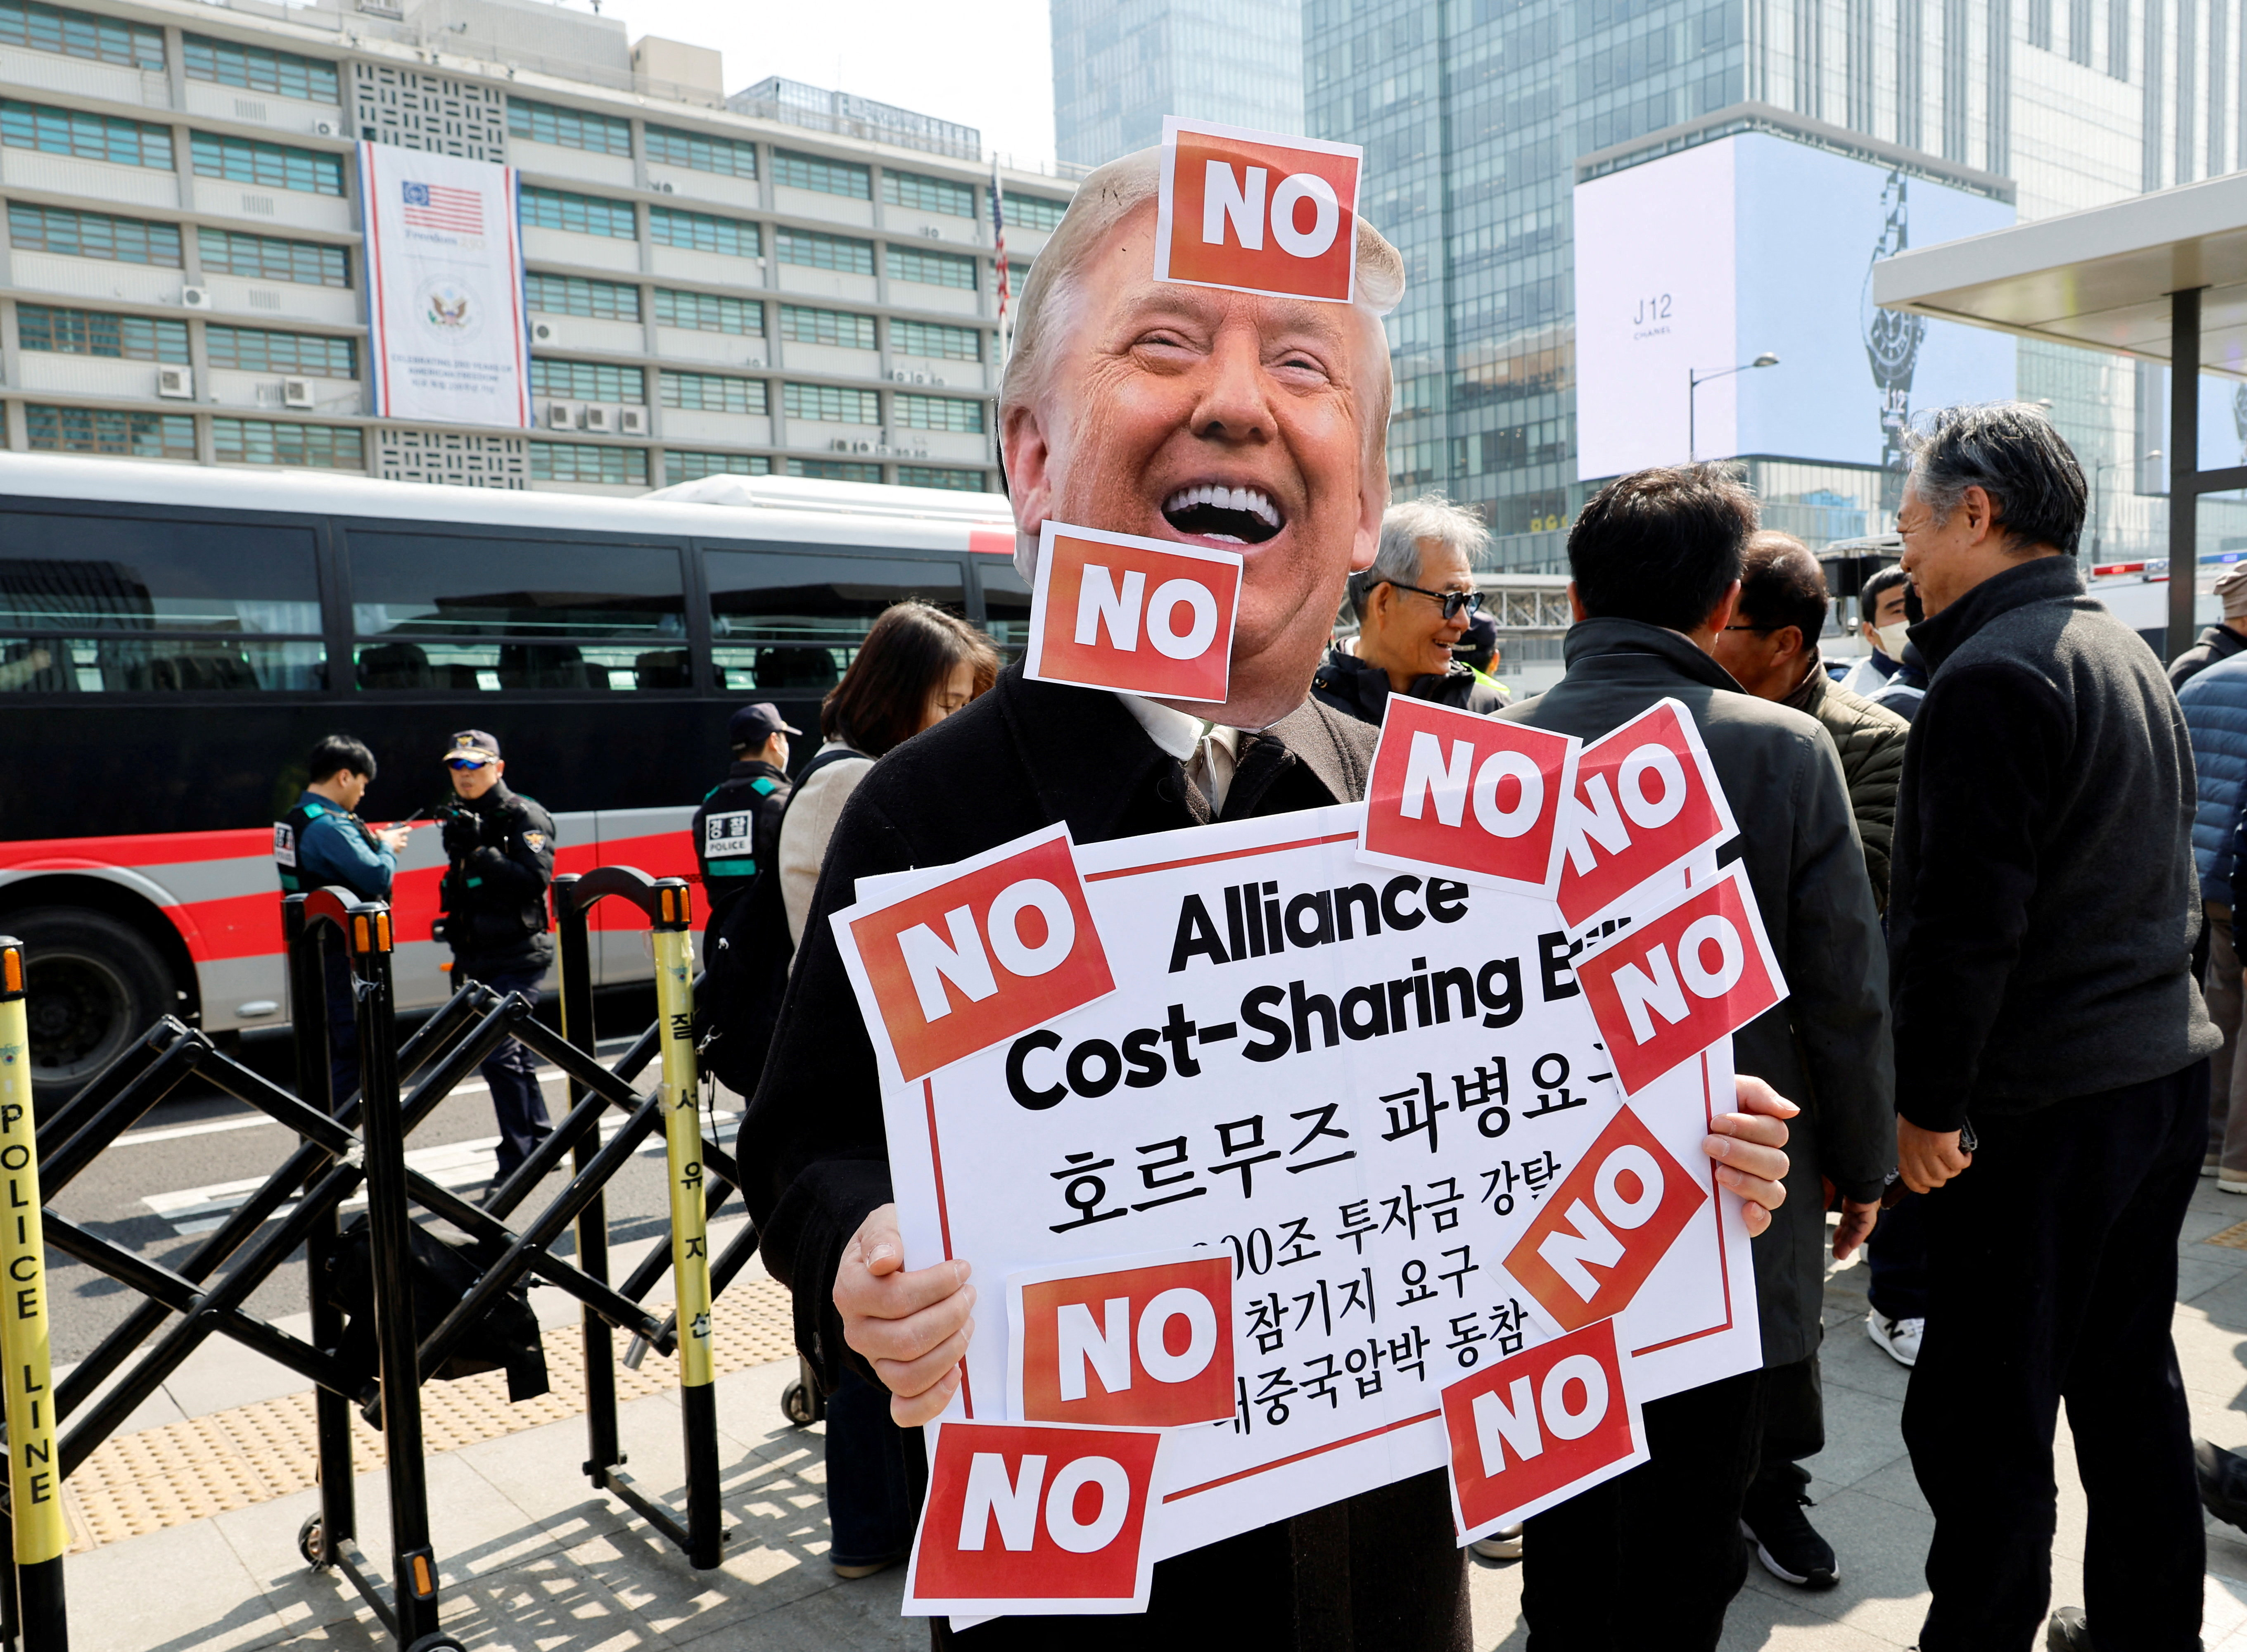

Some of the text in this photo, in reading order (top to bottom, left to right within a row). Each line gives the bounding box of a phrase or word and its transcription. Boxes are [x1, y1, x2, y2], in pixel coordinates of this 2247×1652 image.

[1203, 159, 1339, 258] NO
[1634, 293, 1671, 324] J12
[1075, 563, 1218, 660] NO
[710, 817, 746, 839] 경찰
[1400, 731, 1544, 838] NO
[1567, 743, 1687, 877] NO
[709, 840, 745, 851] POLICE
[896, 878, 1075, 1023] NO
[1168, 875, 1469, 973] Alliance
[1611, 914, 1744, 1046] NO
[1006, 956, 1523, 1111] Cost-Sharing
[1, 1104, 38, 1320] POLICE
[1049, 1103, 1357, 1234] 호르무즈
[1192, 1151, 1561, 1281] 00조 투자금 강탈
[1537, 1144, 1664, 1304] NO
[1396, 1245, 1479, 1307] 요구
[1445, 1298, 1529, 1367] 동참
[1057, 1287, 1217, 1402] NO
[23, 1365, 51, 1505] LINE
[1472, 1354, 1609, 1479] NO
[957, 1452, 1130, 1554] NO
